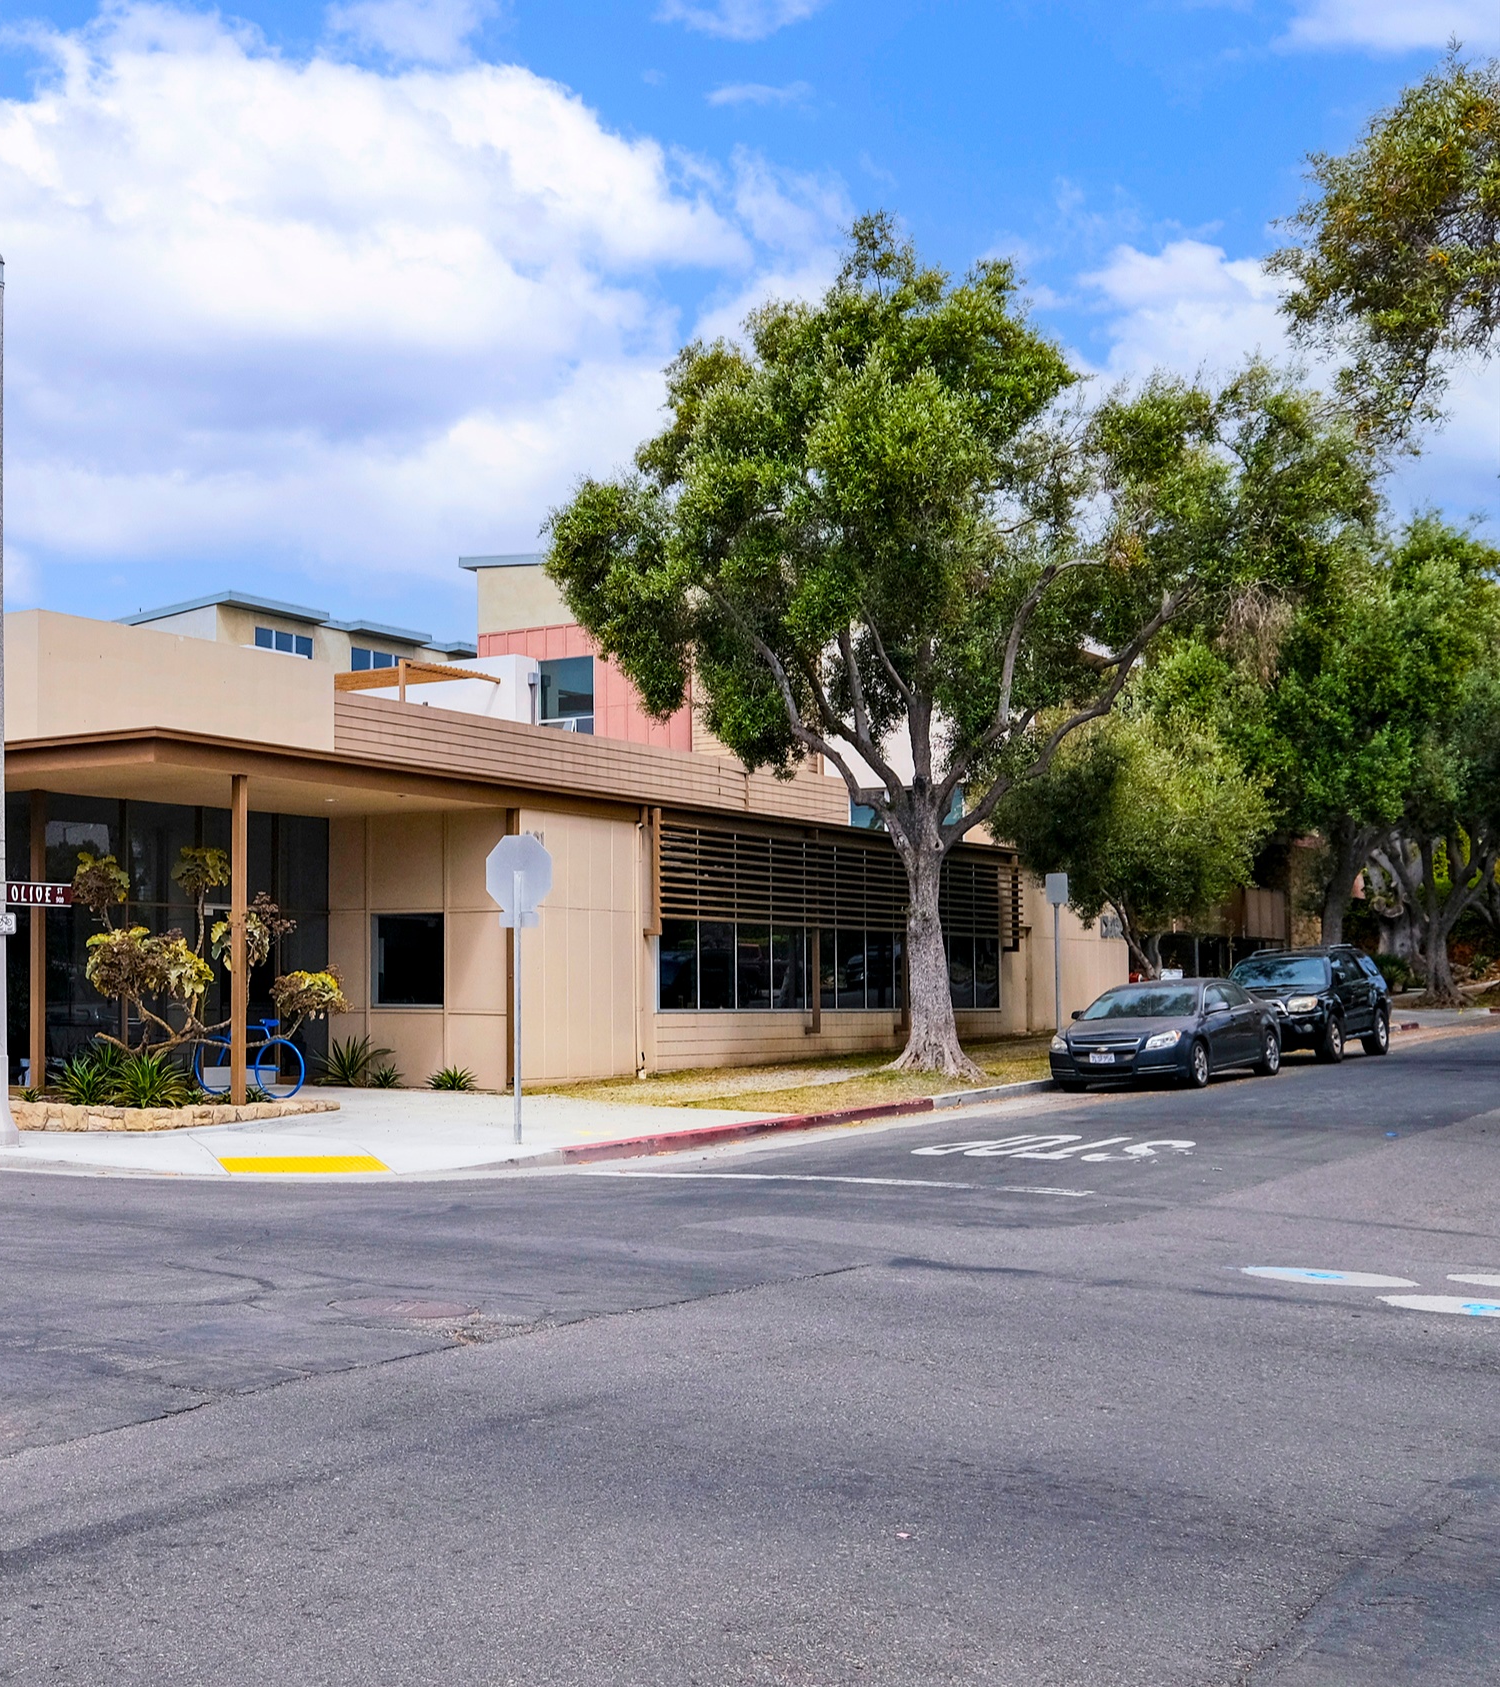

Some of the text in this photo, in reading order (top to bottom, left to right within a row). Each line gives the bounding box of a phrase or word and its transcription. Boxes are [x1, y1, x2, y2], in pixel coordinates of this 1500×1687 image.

[11, 885, 52, 903] OLIVE
[57, 887, 63, 895] ST
[910, 1134, 1198, 1164] STOP
